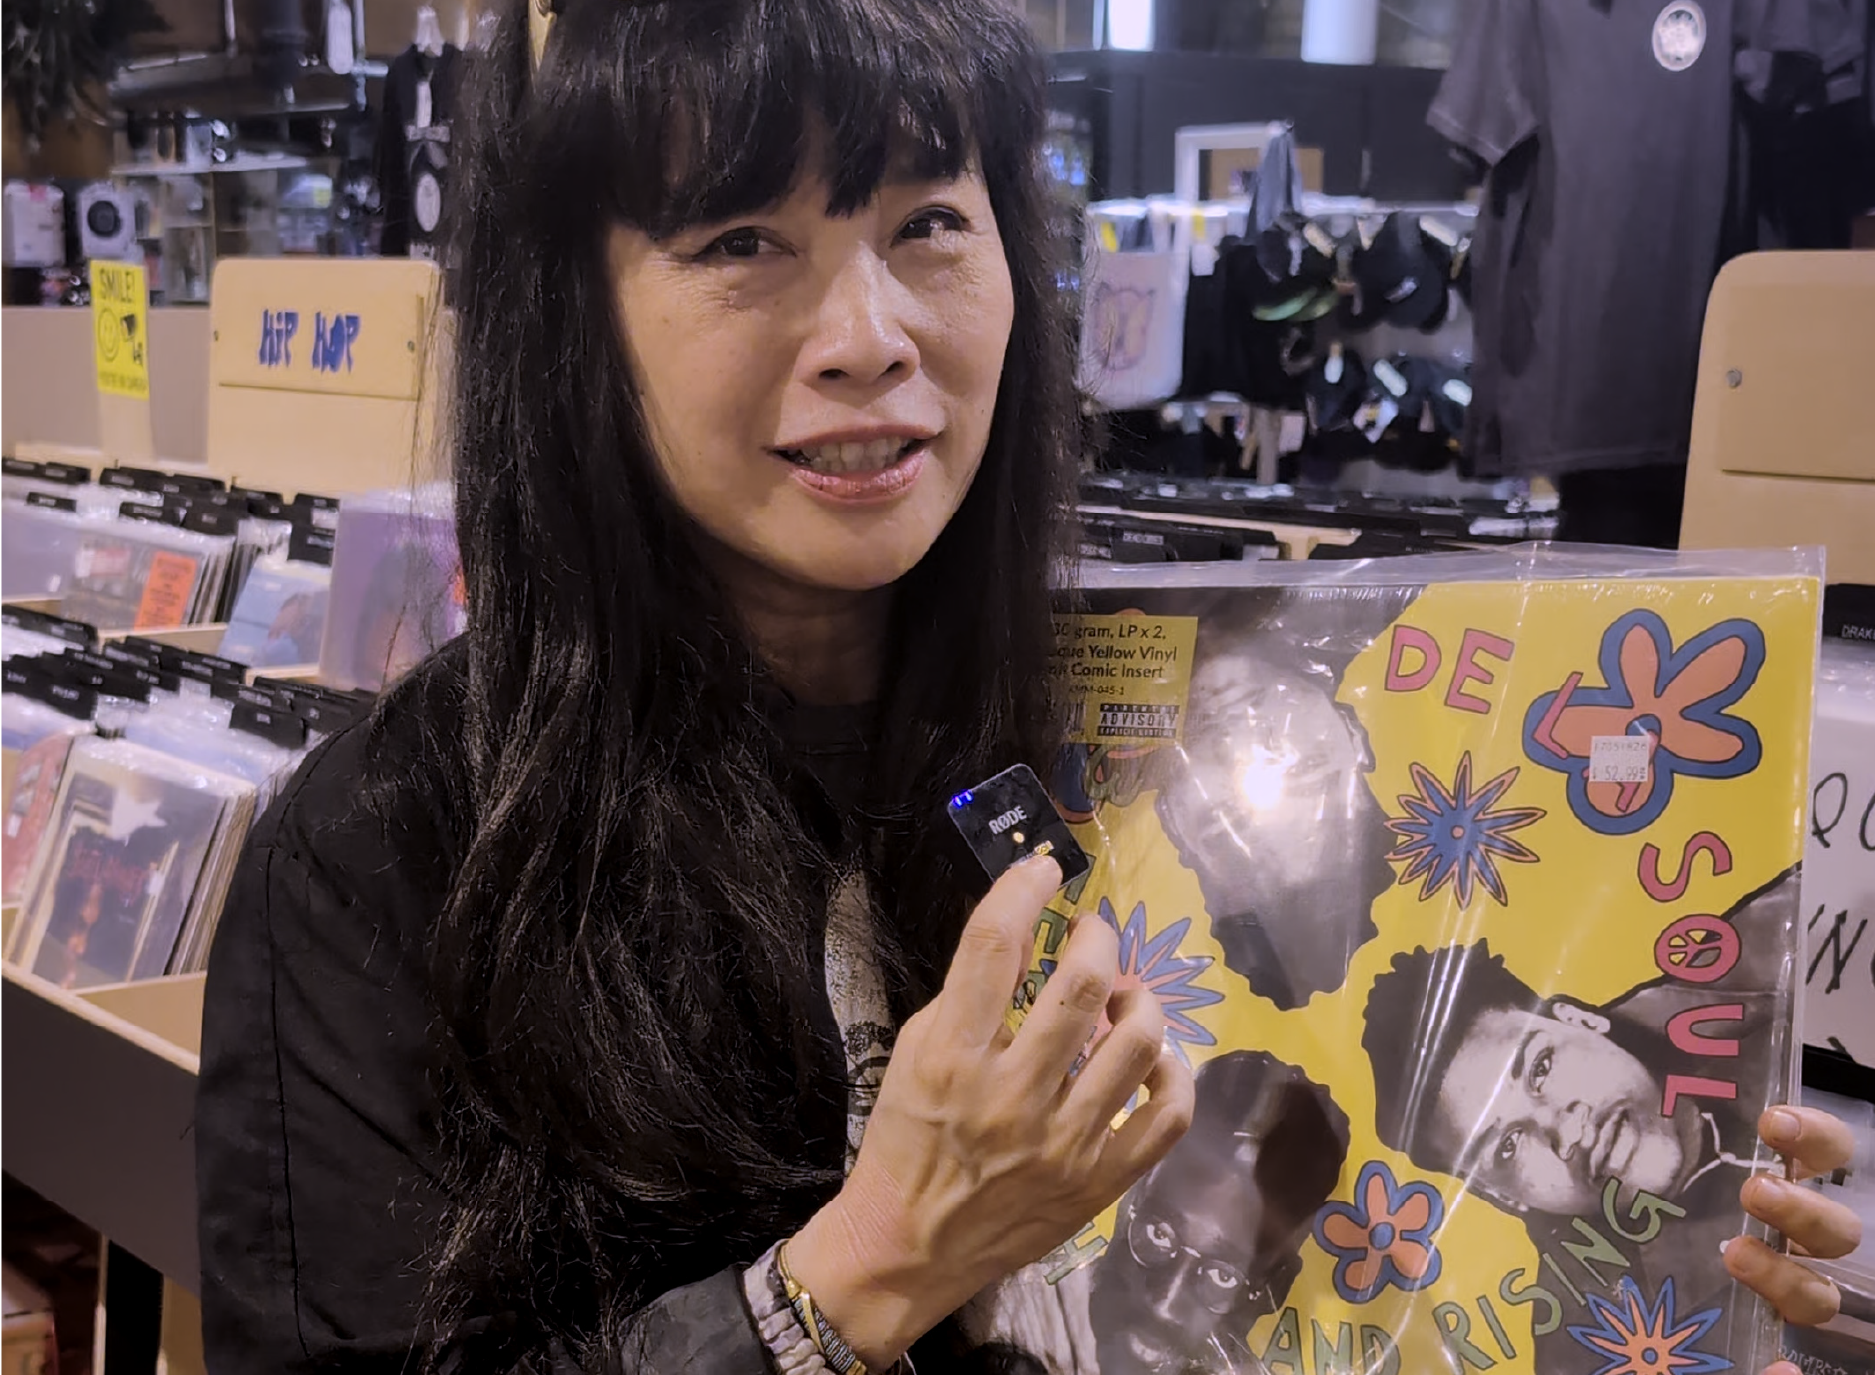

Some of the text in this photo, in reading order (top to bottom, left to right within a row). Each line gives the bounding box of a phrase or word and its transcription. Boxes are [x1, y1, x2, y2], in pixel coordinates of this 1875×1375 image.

[99, 267, 136, 304] SMILE!
[312, 310, 361, 375] HOP
[1118, 623, 1138, 638] LP
[1087, 645, 1136, 661] Yellow
[1139, 646, 1178, 663] Vinyl
[1070, 662, 1117, 678] Comic
[1121, 664, 1165, 679] Insert
[1100, 712, 1177, 727] ADVISORY
[1384, 625, 1515, 714] DE
[1637, 831, 1743, 1118] SOUL
[1261, 1177, 1687, 1375] AND RISING
